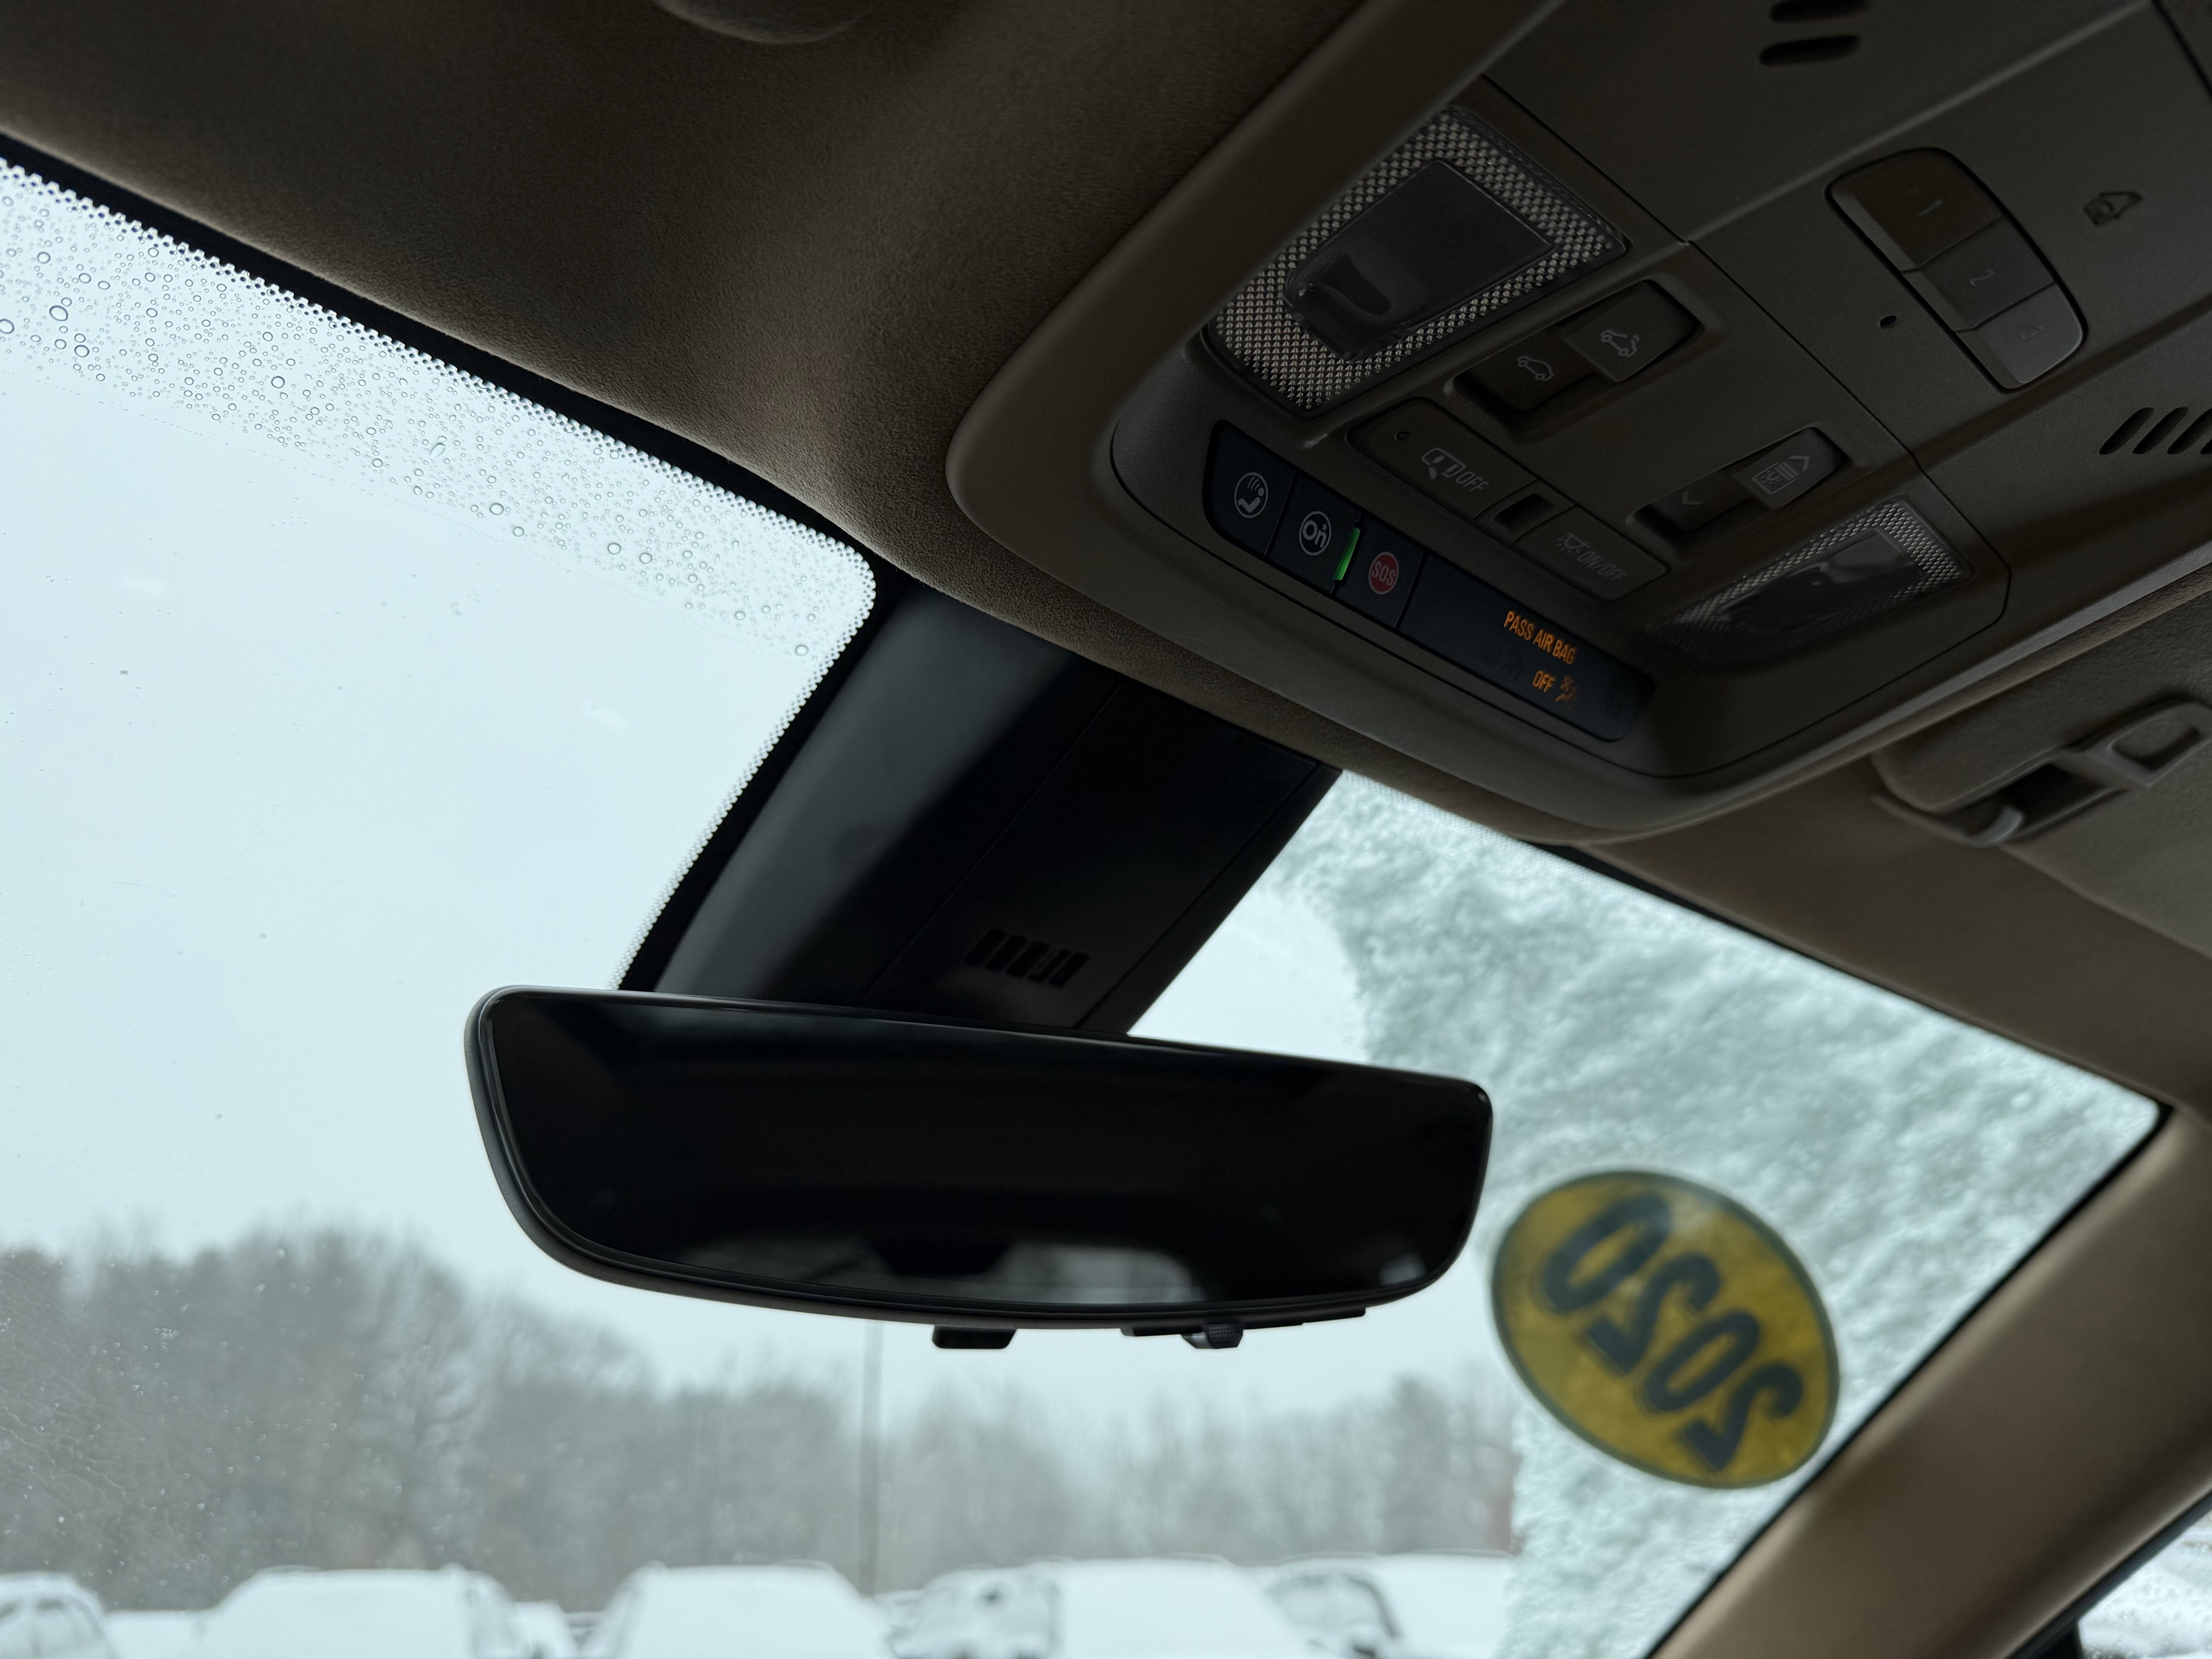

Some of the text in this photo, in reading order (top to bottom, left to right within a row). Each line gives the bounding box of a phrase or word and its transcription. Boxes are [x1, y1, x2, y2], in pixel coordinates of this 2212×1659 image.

[1918, 199, 1943, 217] 1
[1969, 269, 1994, 286] 2
[1455, 471, 1489, 492] OFF
[1302, 520, 1328, 549] On
[1371, 560, 1396, 586] SOS
[1576, 551, 1627, 581] ON/OFF
[1503, 610, 1576, 665] PASS AIR BAG
[1532, 670, 1556, 692] OFF
